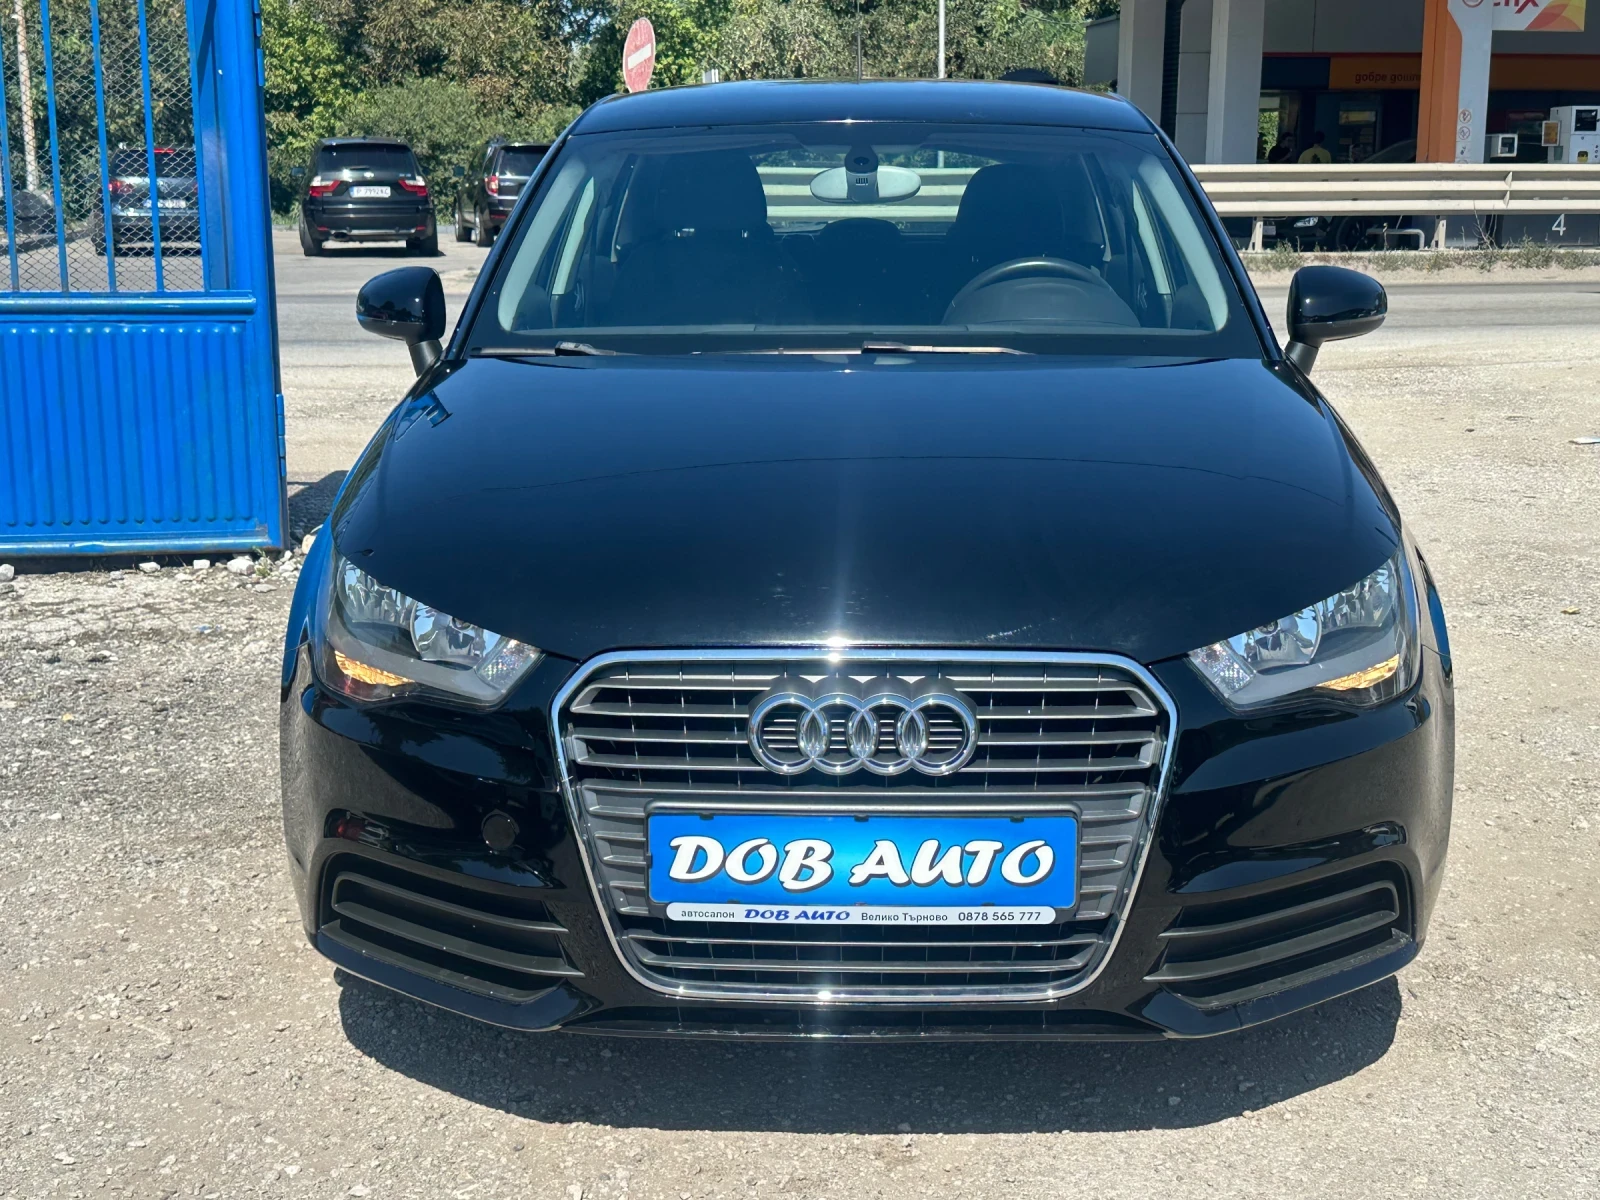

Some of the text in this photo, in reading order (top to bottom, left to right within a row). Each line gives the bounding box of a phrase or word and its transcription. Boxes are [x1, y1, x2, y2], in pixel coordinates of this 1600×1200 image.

[1390, 73, 1421, 84] дошл
[1551, 213, 1567, 236] 4
[669, 835, 1055, 893] DOB AUTO
[681, 908, 1041, 923] автосалон DOB AUTO Велико Търново 0878 565 777
